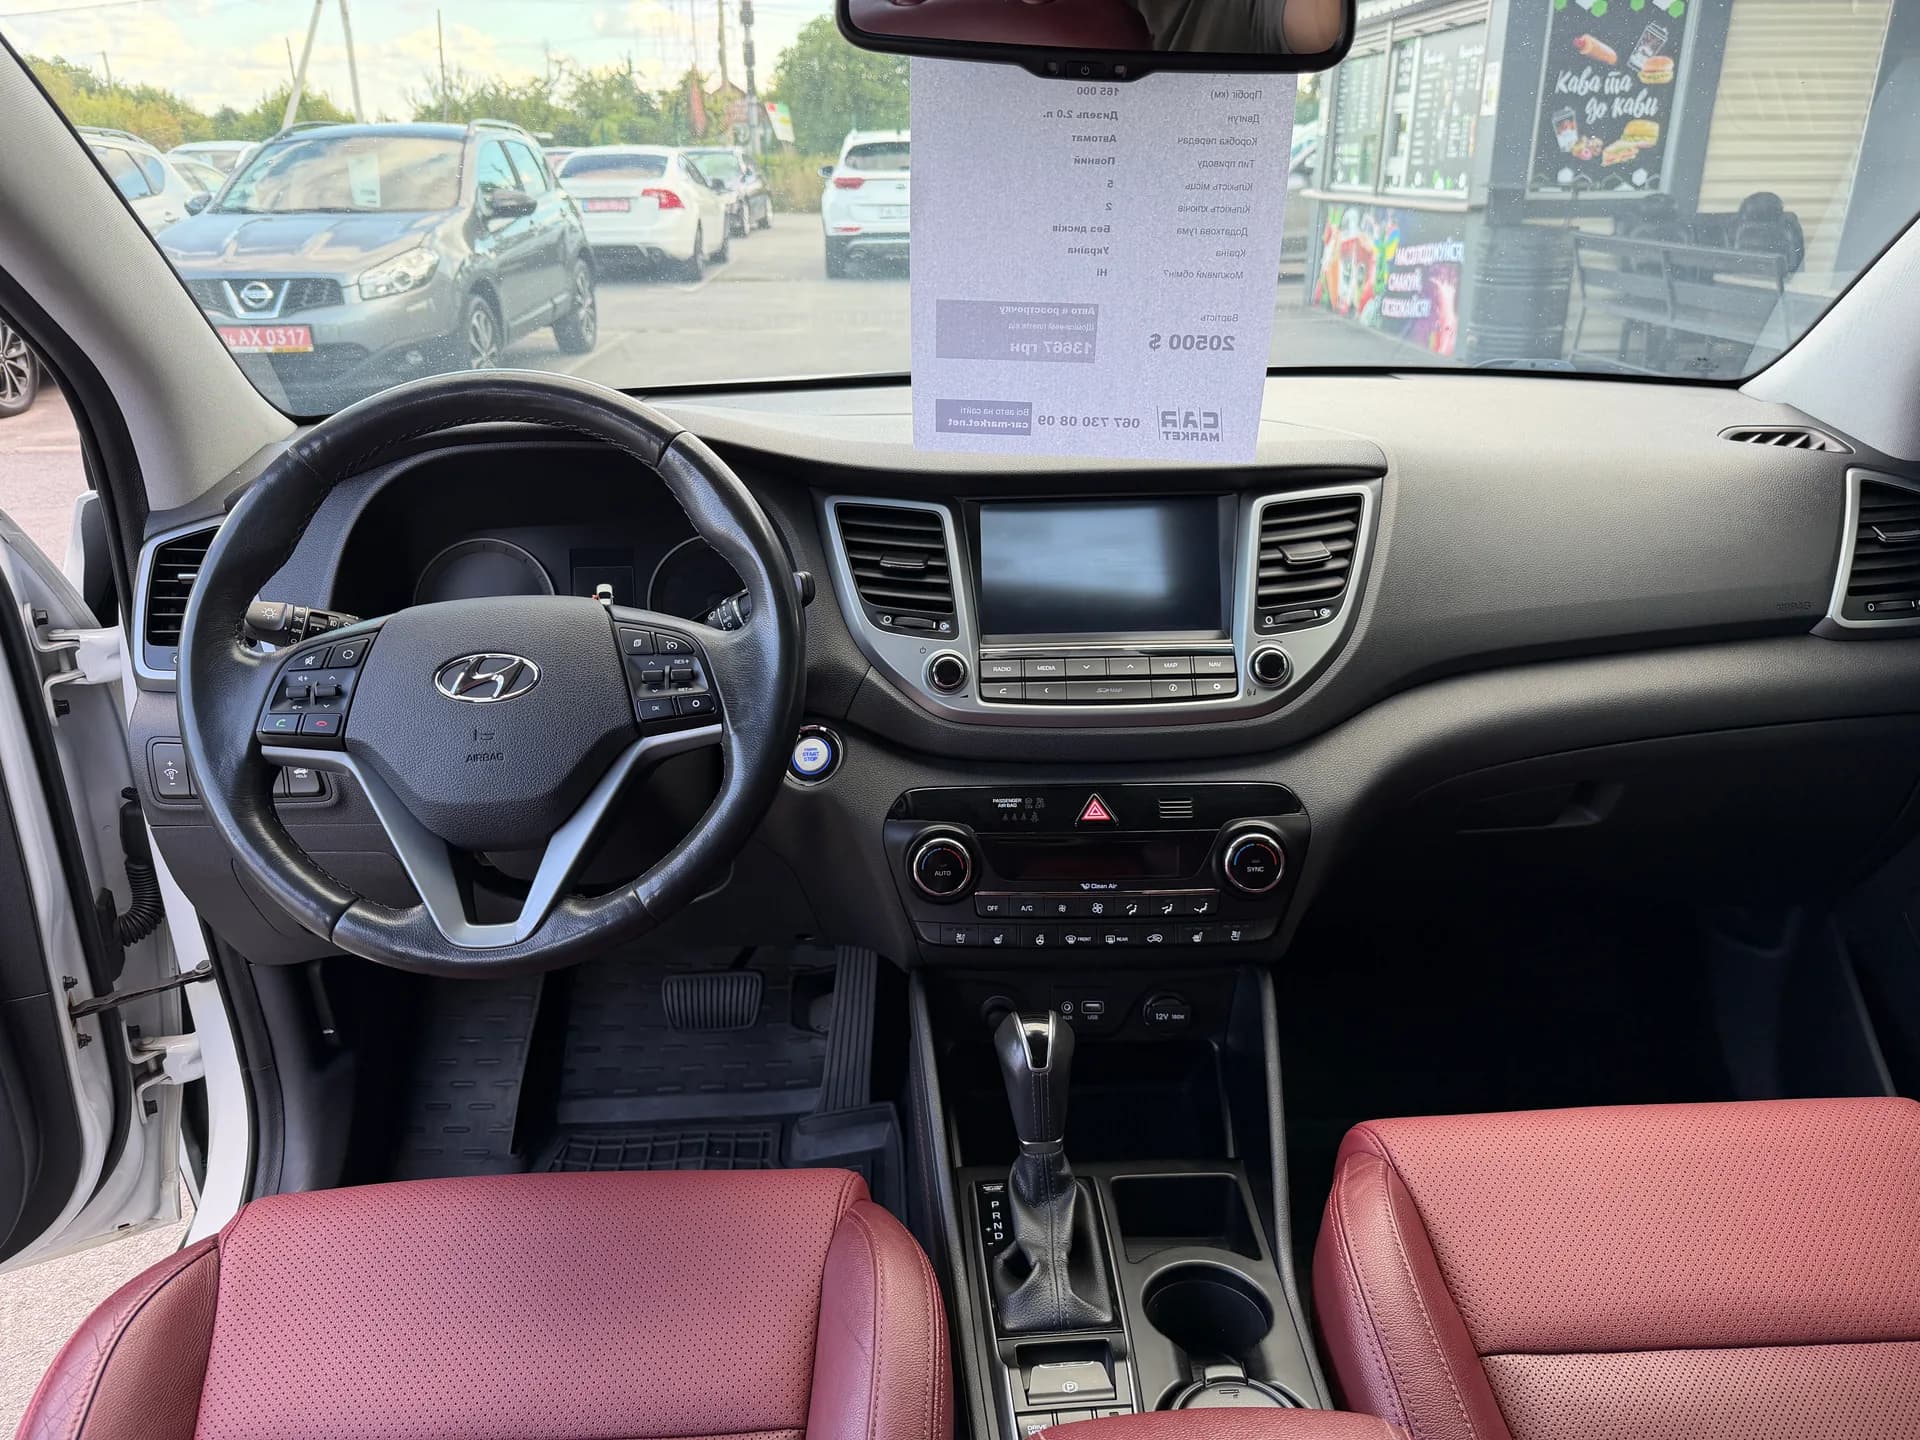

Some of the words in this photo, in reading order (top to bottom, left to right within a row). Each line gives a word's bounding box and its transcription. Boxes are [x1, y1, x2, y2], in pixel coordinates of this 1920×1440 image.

[1555, 66, 1601, 96] Кава
[1585, 97, 1607, 124] до
[1611, 88, 1658, 118] кави
[238, 329, 263, 347] AX
[266, 329, 305, 346] 0317
[465, 752, 504, 763] AIRBAG
[991, 1200, 1000, 1208] P
[993, 1222, 1003, 1230] N
[994, 1232, 1004, 1240] D
